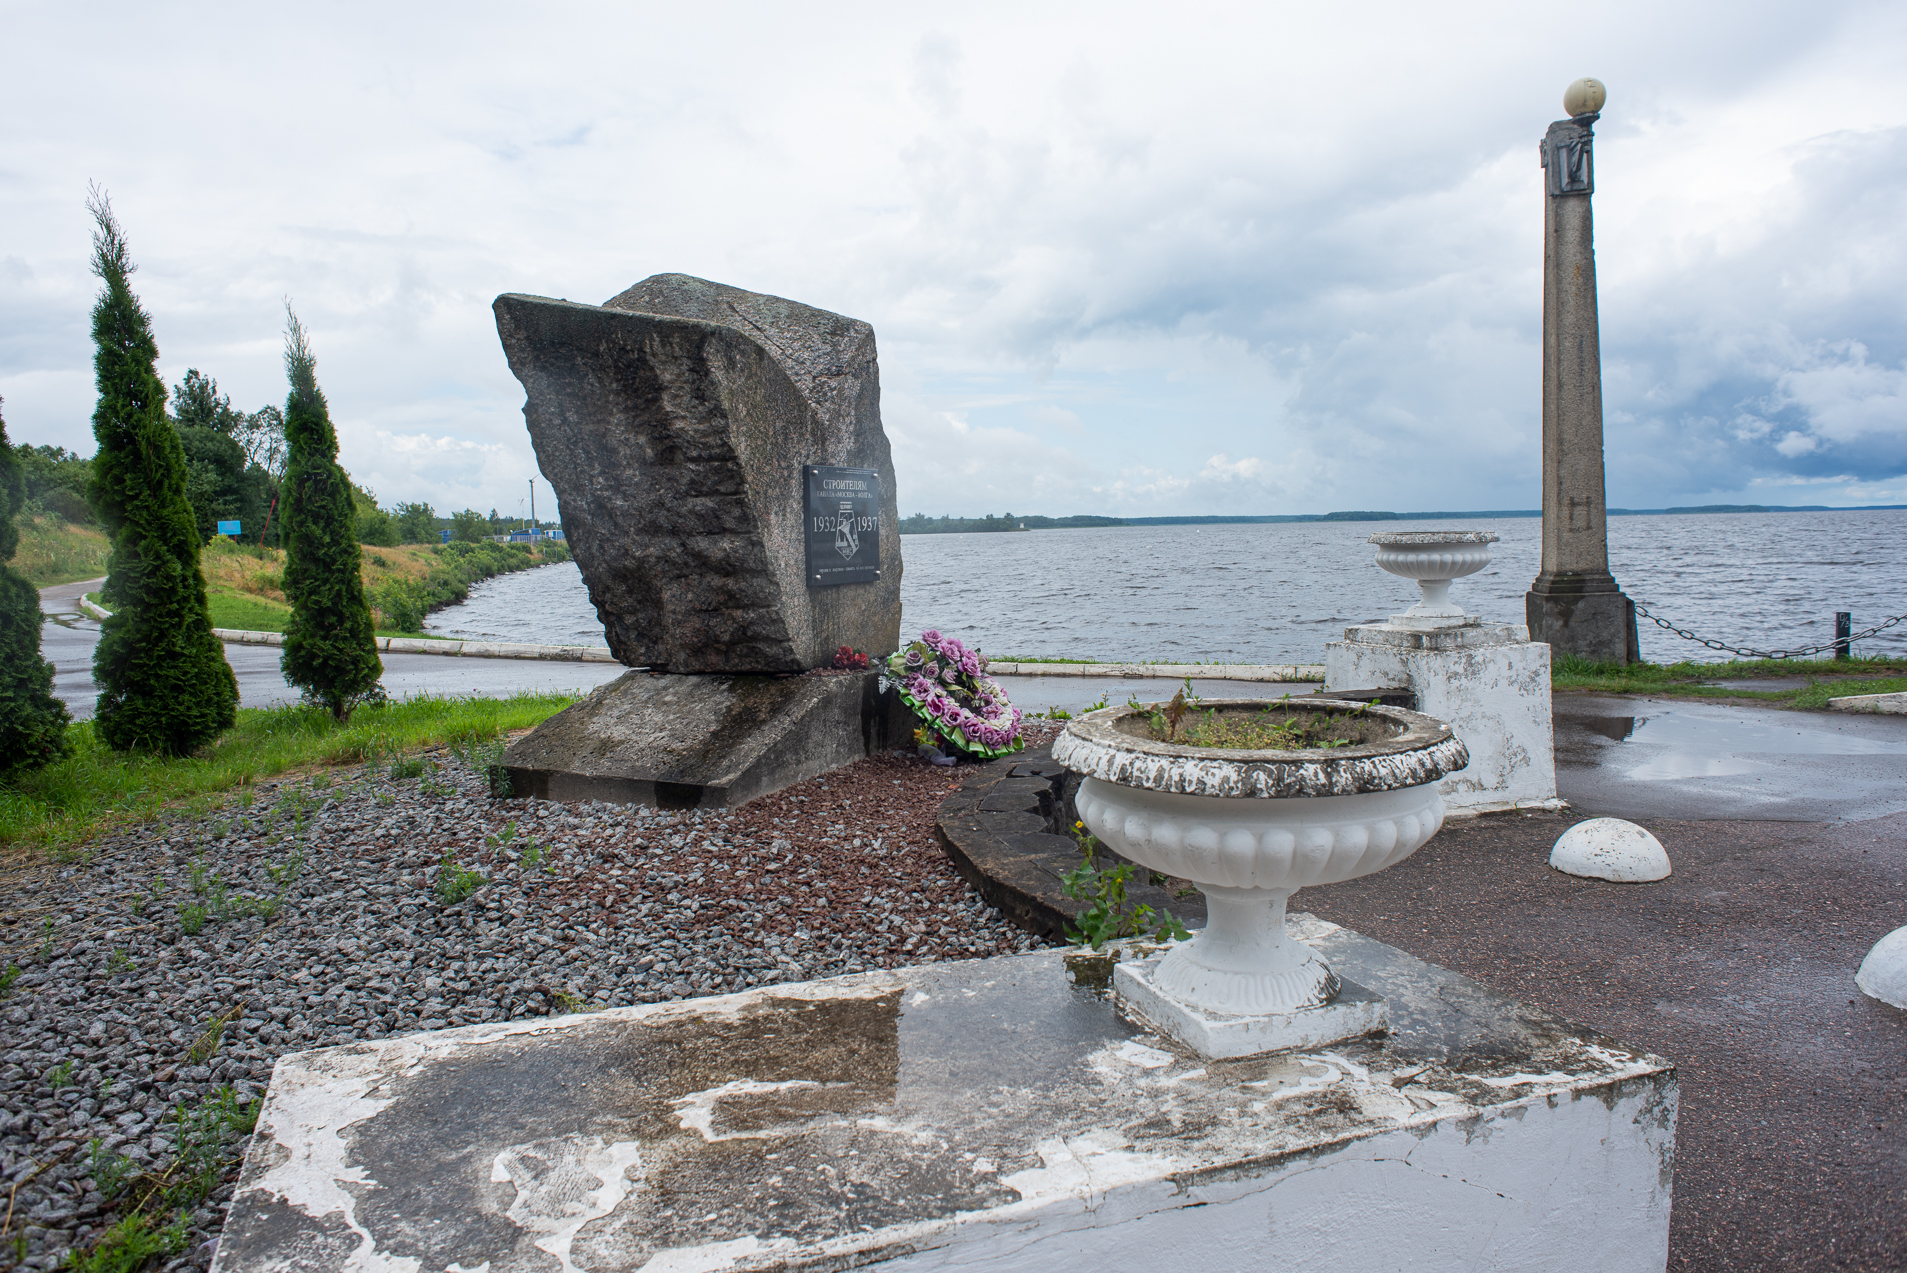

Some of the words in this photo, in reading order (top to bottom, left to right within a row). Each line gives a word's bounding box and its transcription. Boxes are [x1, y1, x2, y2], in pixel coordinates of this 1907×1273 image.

[823, 479, 868, 490] СТРОИТЕЛЯМ
[814, 516, 836, 532] 1932
[857, 516, 878, 532] 1937
